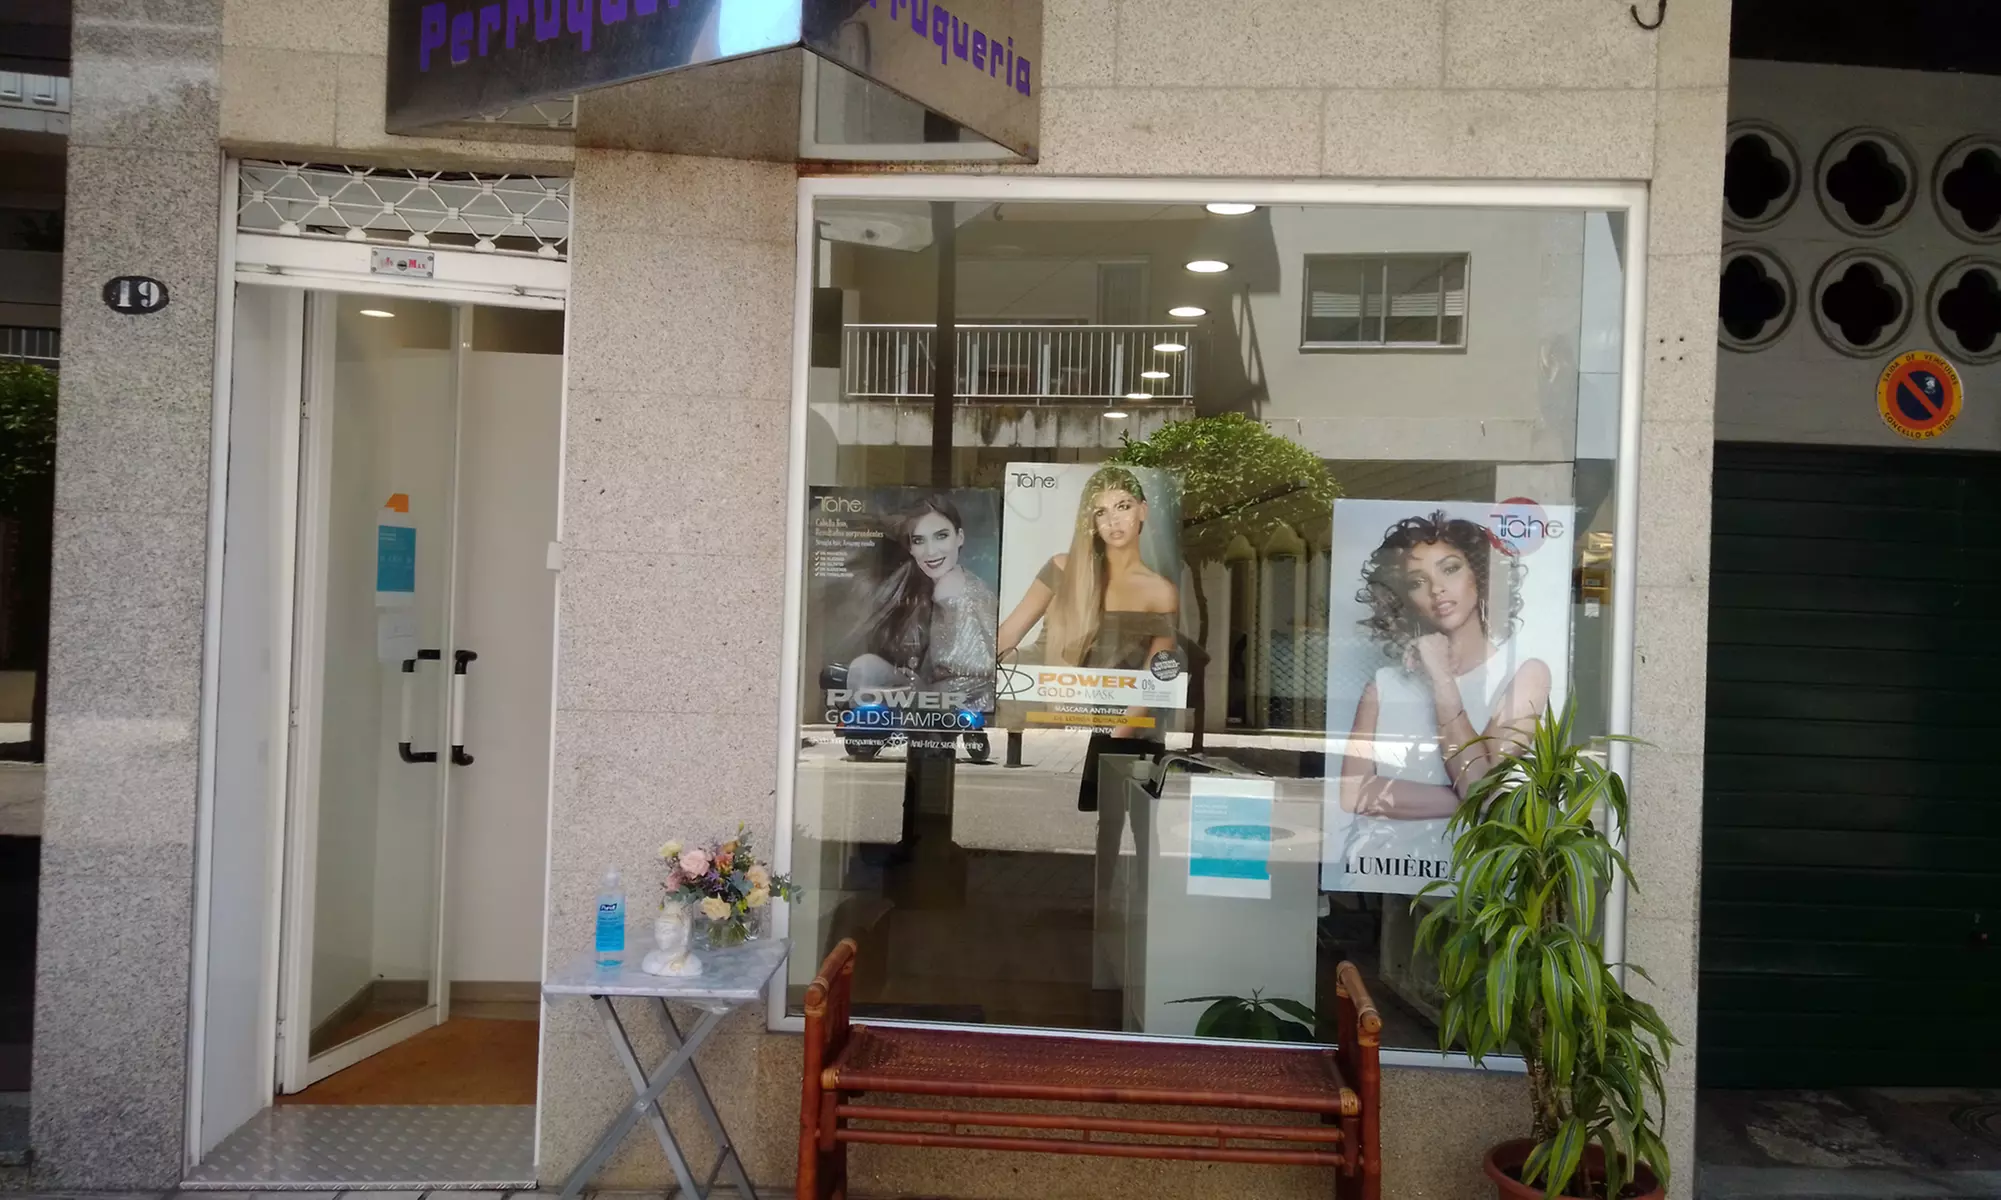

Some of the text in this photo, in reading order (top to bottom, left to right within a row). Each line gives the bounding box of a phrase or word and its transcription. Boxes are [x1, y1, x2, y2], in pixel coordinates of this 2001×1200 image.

[420, 0, 680, 72] Perruqu
[116, 280, 160, 308] 19
[1011, 472, 1056, 489] Tahe
[814, 495, 863, 513] Tahe
[1490, 515, 1564, 539] Tahe
[1038, 672, 1138, 689] POWER
[826, 688, 968, 710] POWER
[825, 709, 971, 729] GOLDSHAMPOO
[1344, 853, 1449, 879] LUMIÈRE
